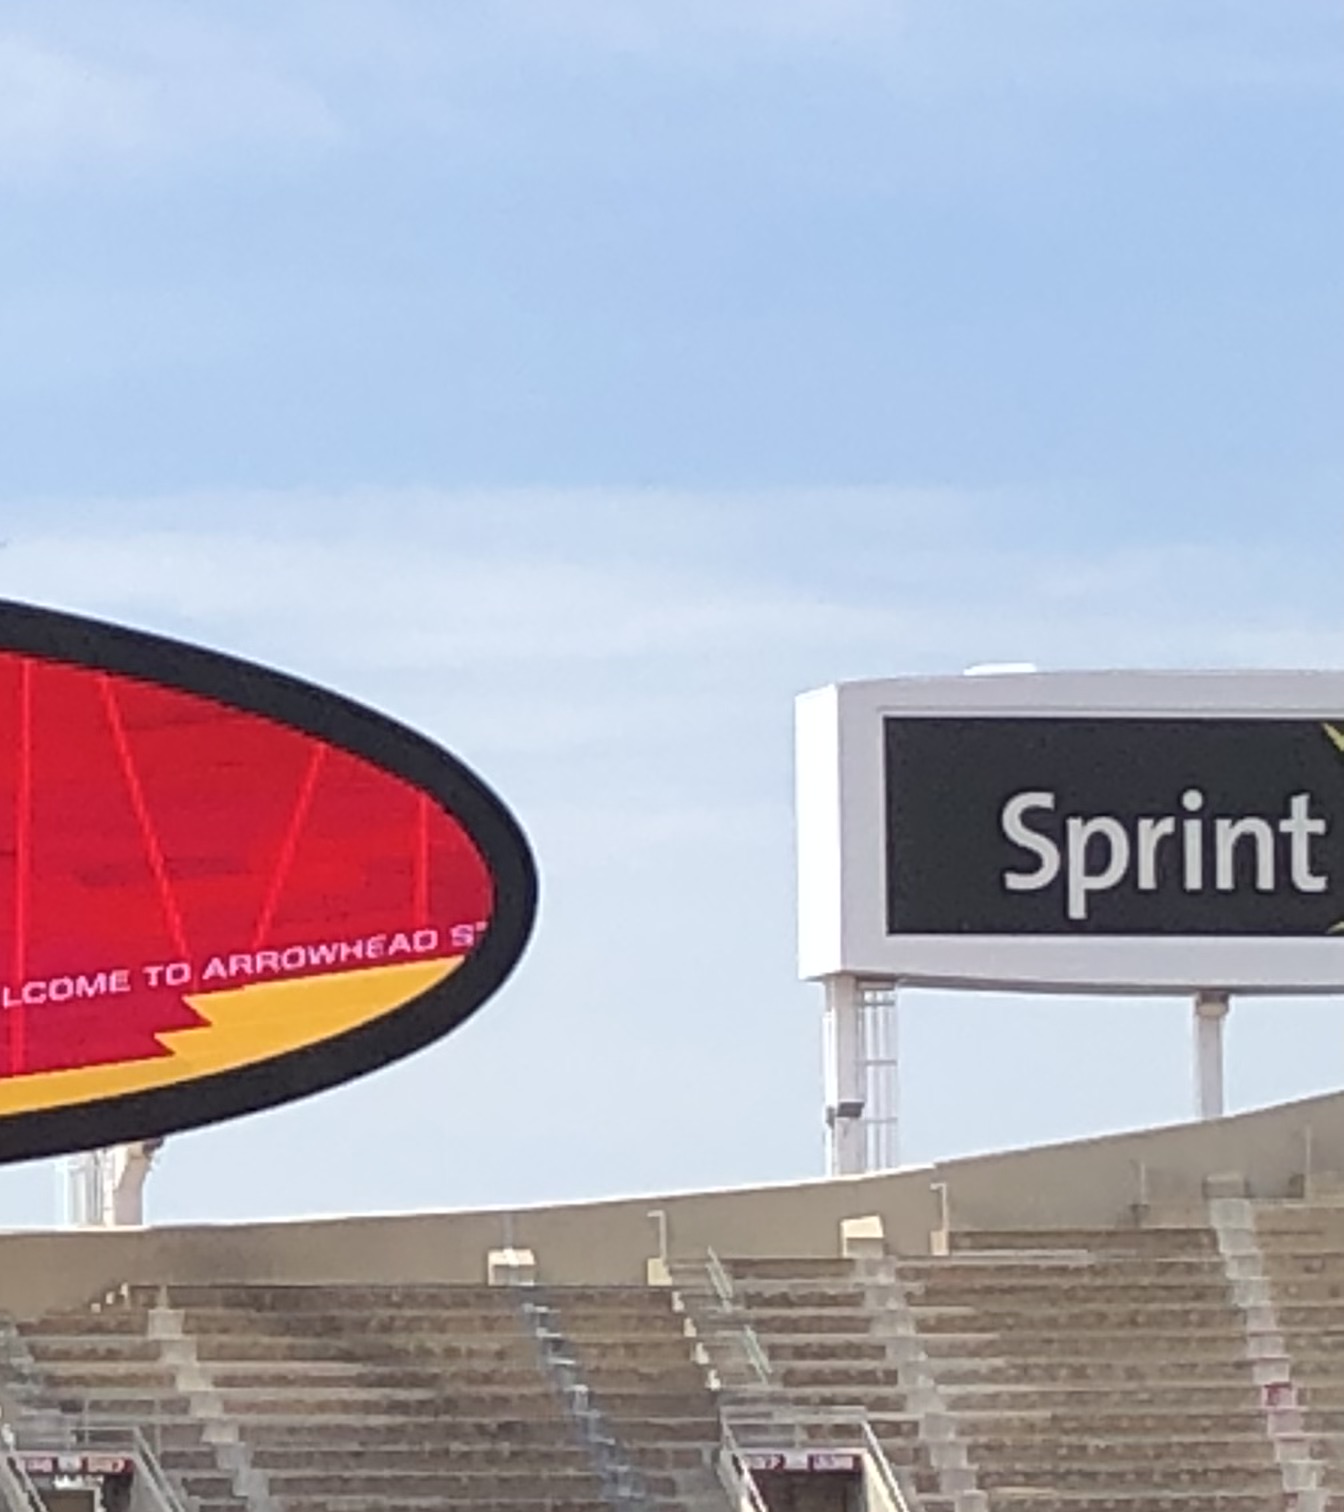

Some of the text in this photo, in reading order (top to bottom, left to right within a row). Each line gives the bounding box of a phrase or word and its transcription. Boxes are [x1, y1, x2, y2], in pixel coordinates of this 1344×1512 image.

[1001, 790, 1328, 920] Sprint
[144, 962, 191, 987] TO
[202, 930, 438, 980] ARROWHEAD
